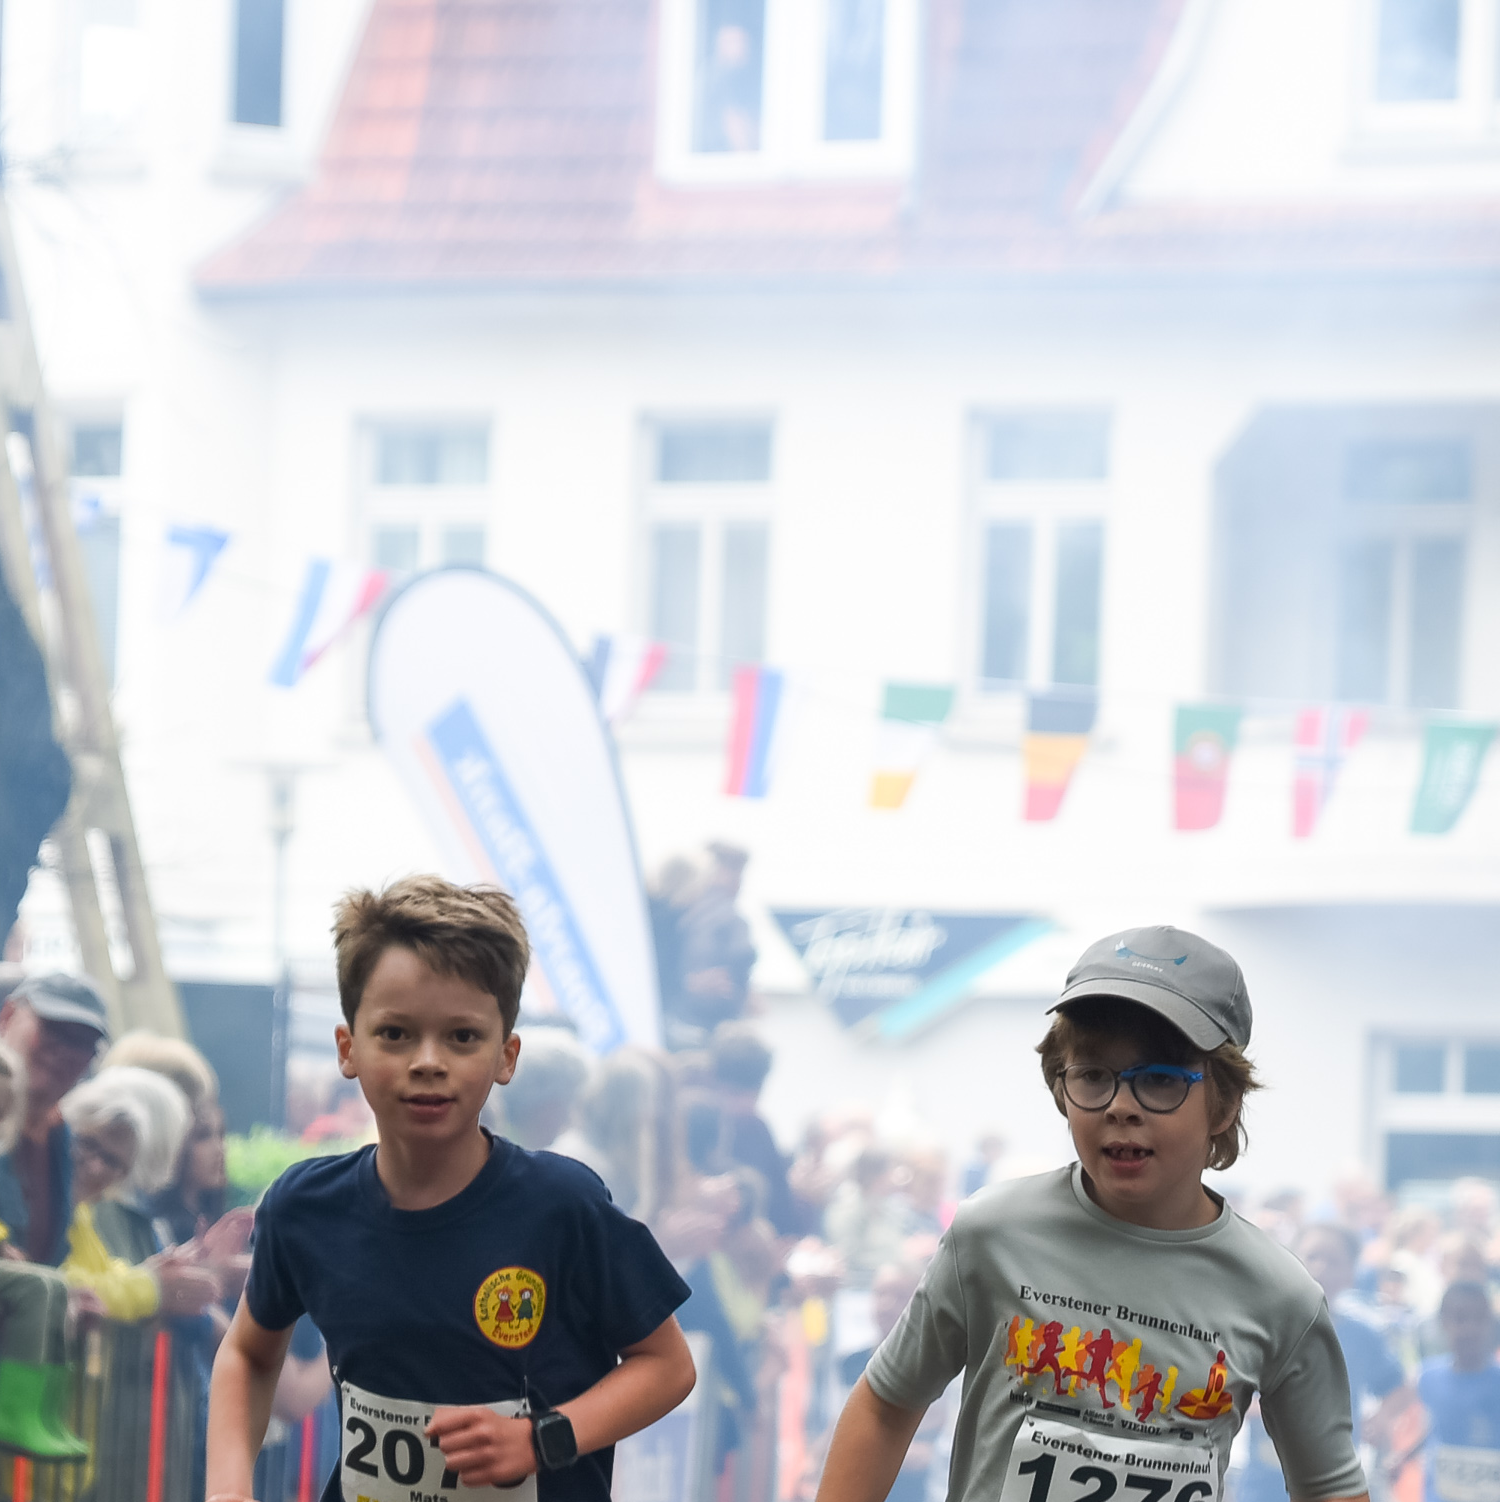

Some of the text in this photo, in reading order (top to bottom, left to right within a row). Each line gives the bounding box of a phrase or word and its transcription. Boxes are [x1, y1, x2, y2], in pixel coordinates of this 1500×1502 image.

[1019, 1284, 1221, 1345] Everstener Brunnenlauf
[350, 1397, 419, 1426] Everstener
[1031, 1430, 1121, 1464] Everstener
